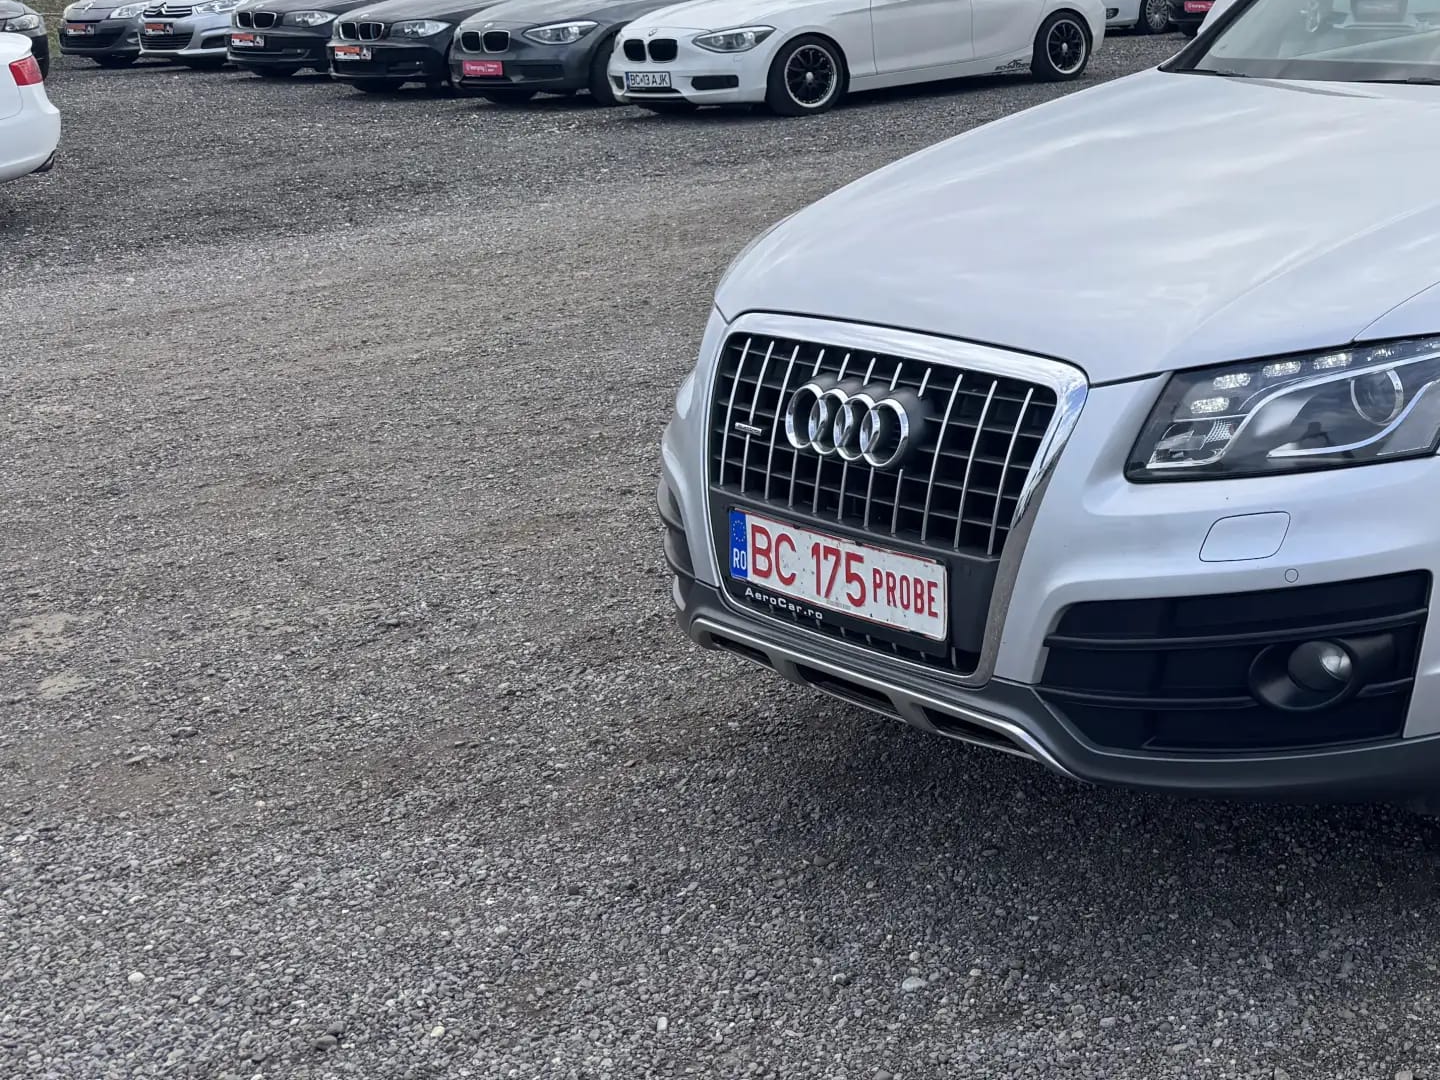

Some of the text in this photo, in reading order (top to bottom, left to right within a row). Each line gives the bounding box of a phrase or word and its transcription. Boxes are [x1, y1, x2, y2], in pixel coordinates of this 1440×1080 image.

[733, 547, 747, 570] RO
[751, 523, 939, 618] BC 175 PROBE
[745, 587, 823, 620] AeroCar.ro
